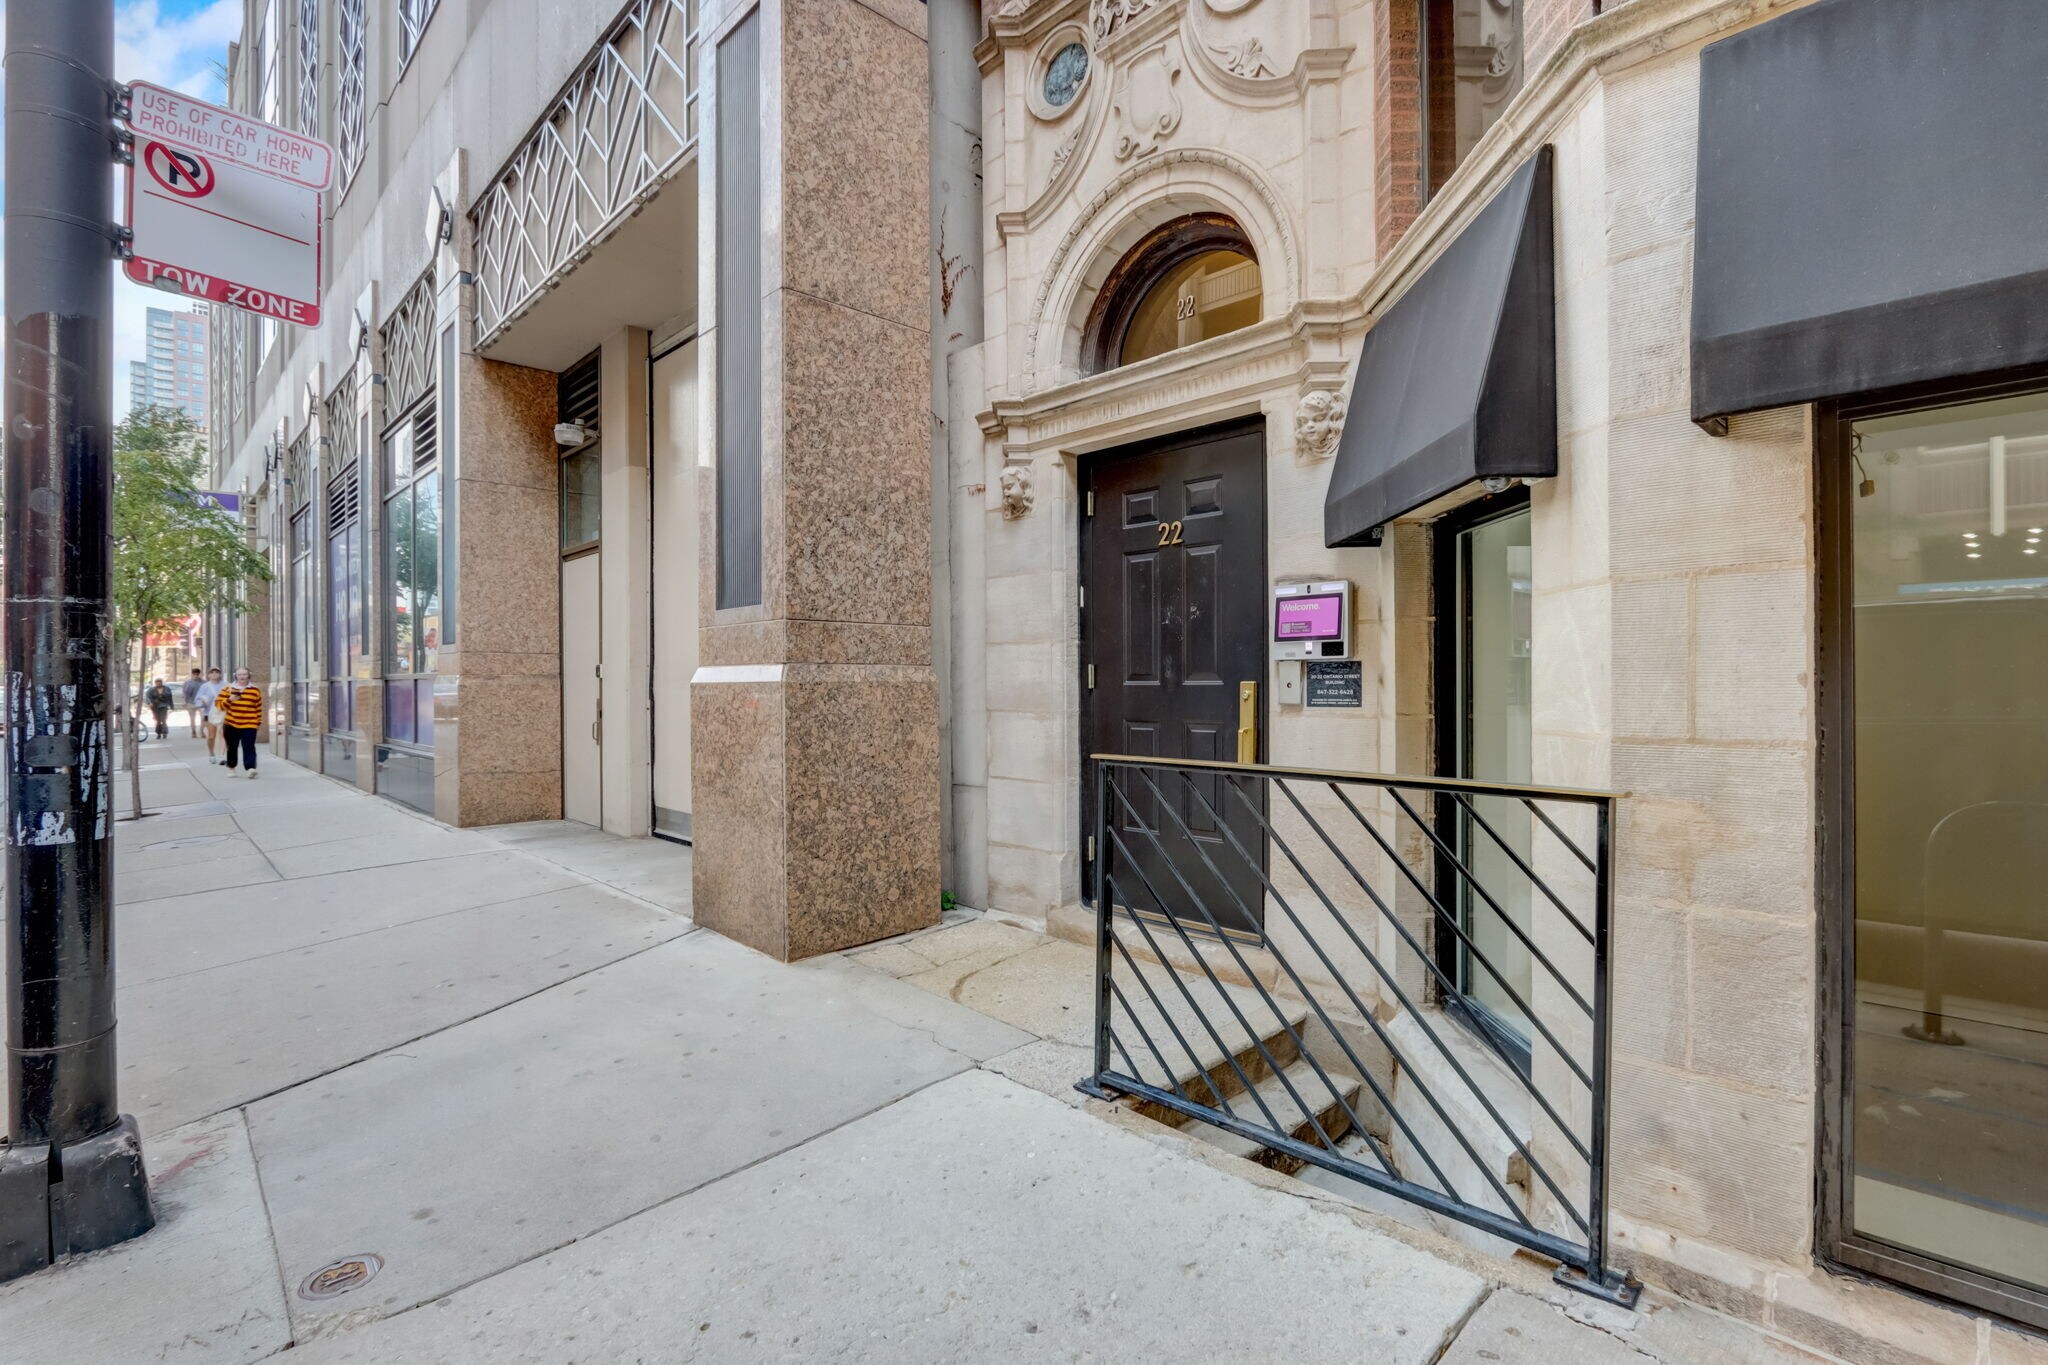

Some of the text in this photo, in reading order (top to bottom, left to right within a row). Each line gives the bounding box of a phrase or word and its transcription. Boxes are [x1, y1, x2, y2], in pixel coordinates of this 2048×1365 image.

[139, 111, 301, 176] PROHIBITED HERE
[142, 91, 313, 161] USE OF CAR HORN
[141, 259, 305, 322] TOW ZONE
[1177, 295, 1195, 320] 22
[1158, 520, 1184, 546] 22
[1281, 603, 1321, 612] Welcome.
